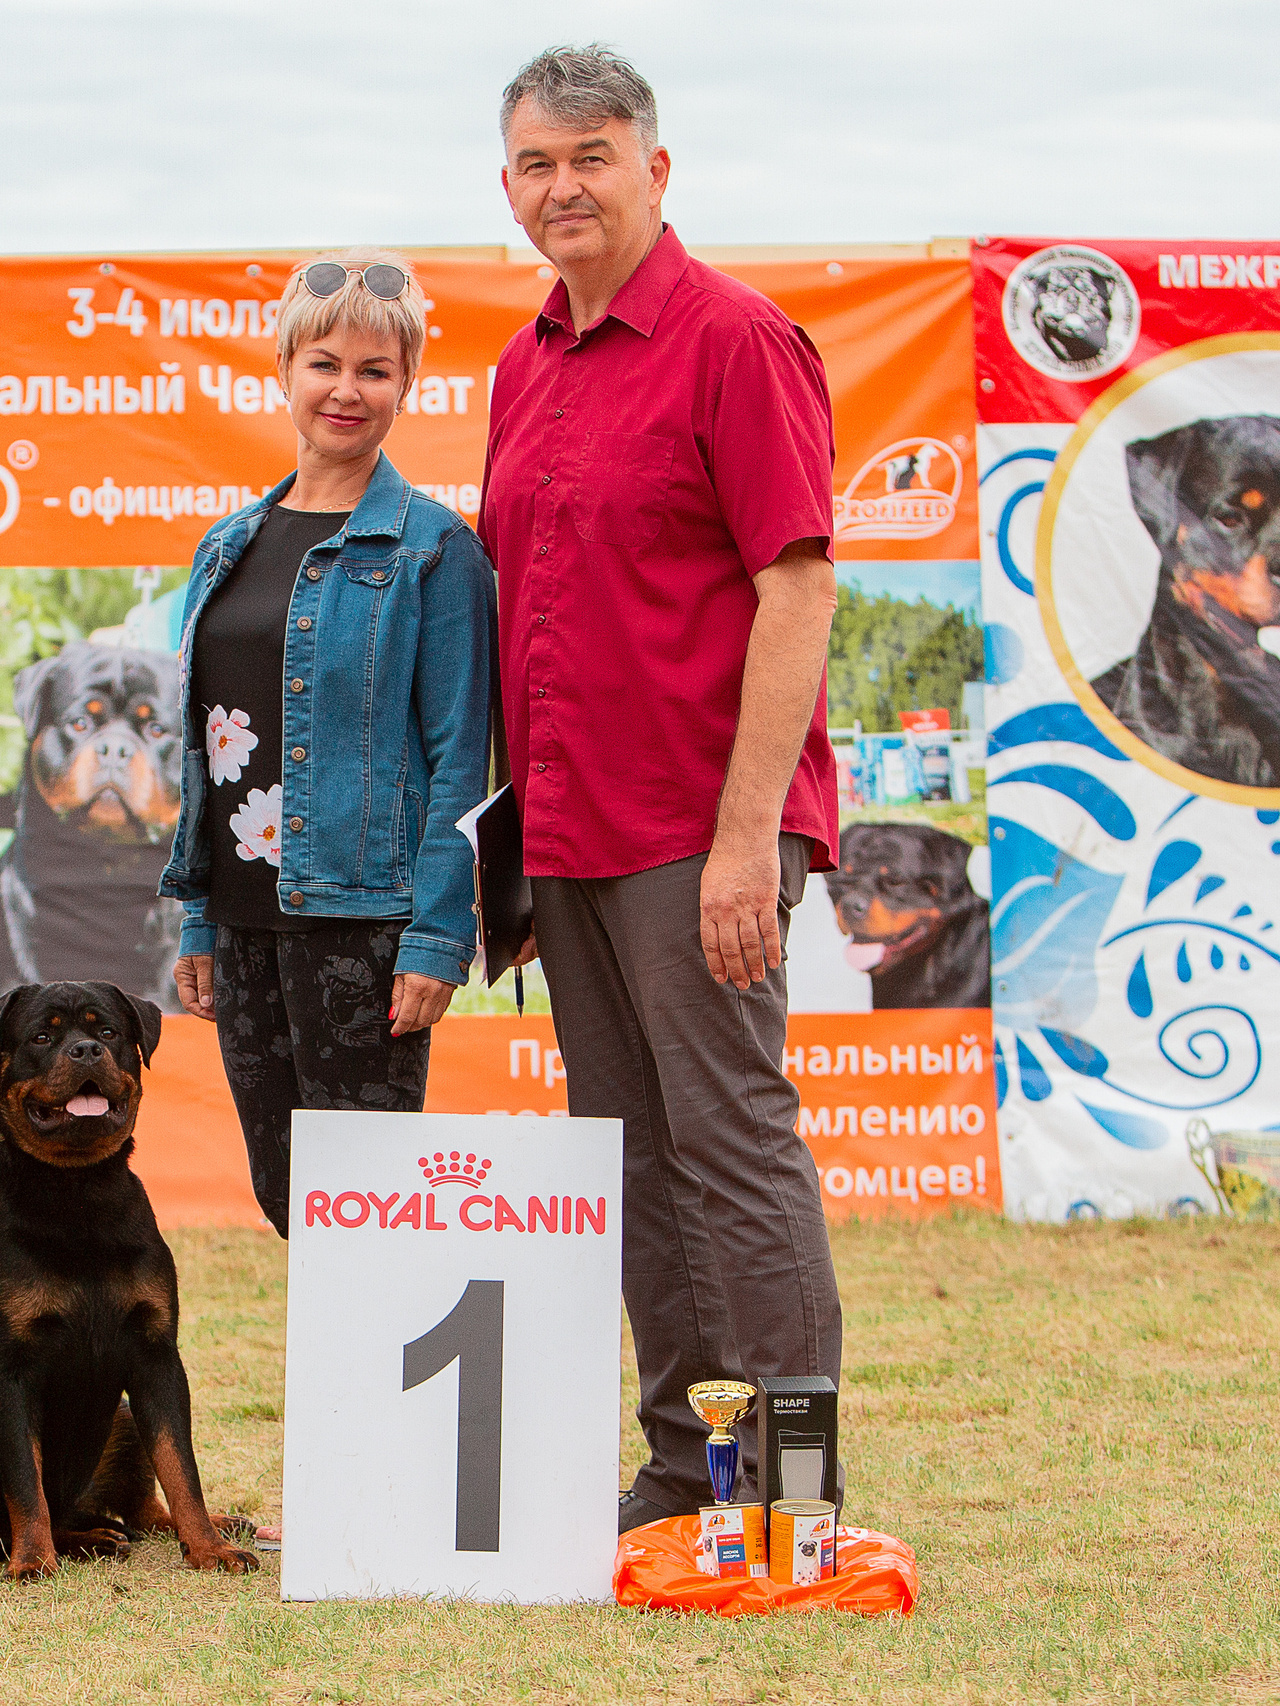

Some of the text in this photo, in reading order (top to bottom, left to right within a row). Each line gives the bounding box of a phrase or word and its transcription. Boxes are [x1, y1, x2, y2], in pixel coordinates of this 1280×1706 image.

[66, 287, 148, 338] 3-4
[305, 1190, 606, 1235] ROYAL CANIN
[402, 1279, 505, 1552] 1
[773, 1398, 810, 1408] SHAPE
